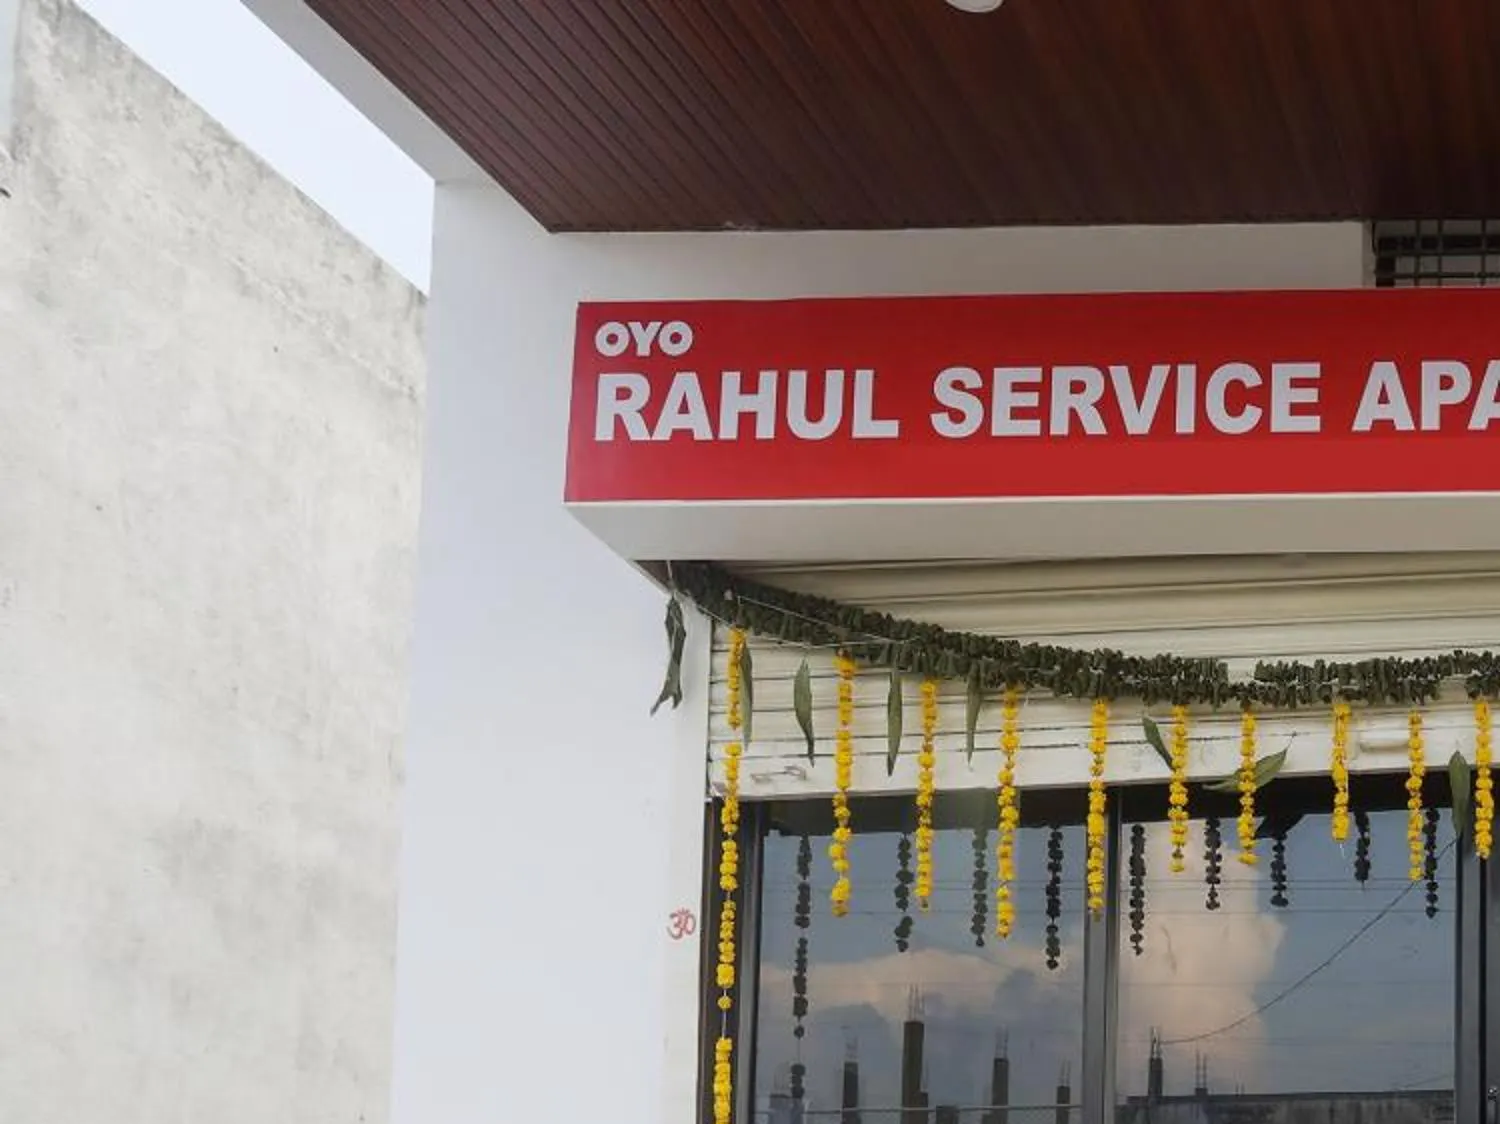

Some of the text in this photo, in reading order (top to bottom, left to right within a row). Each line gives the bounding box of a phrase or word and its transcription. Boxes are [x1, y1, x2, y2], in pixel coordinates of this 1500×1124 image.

[595, 321, 693, 357] OYO
[594, 369, 899, 442] RAHUL
[931, 363, 1322, 438] SERVICE
